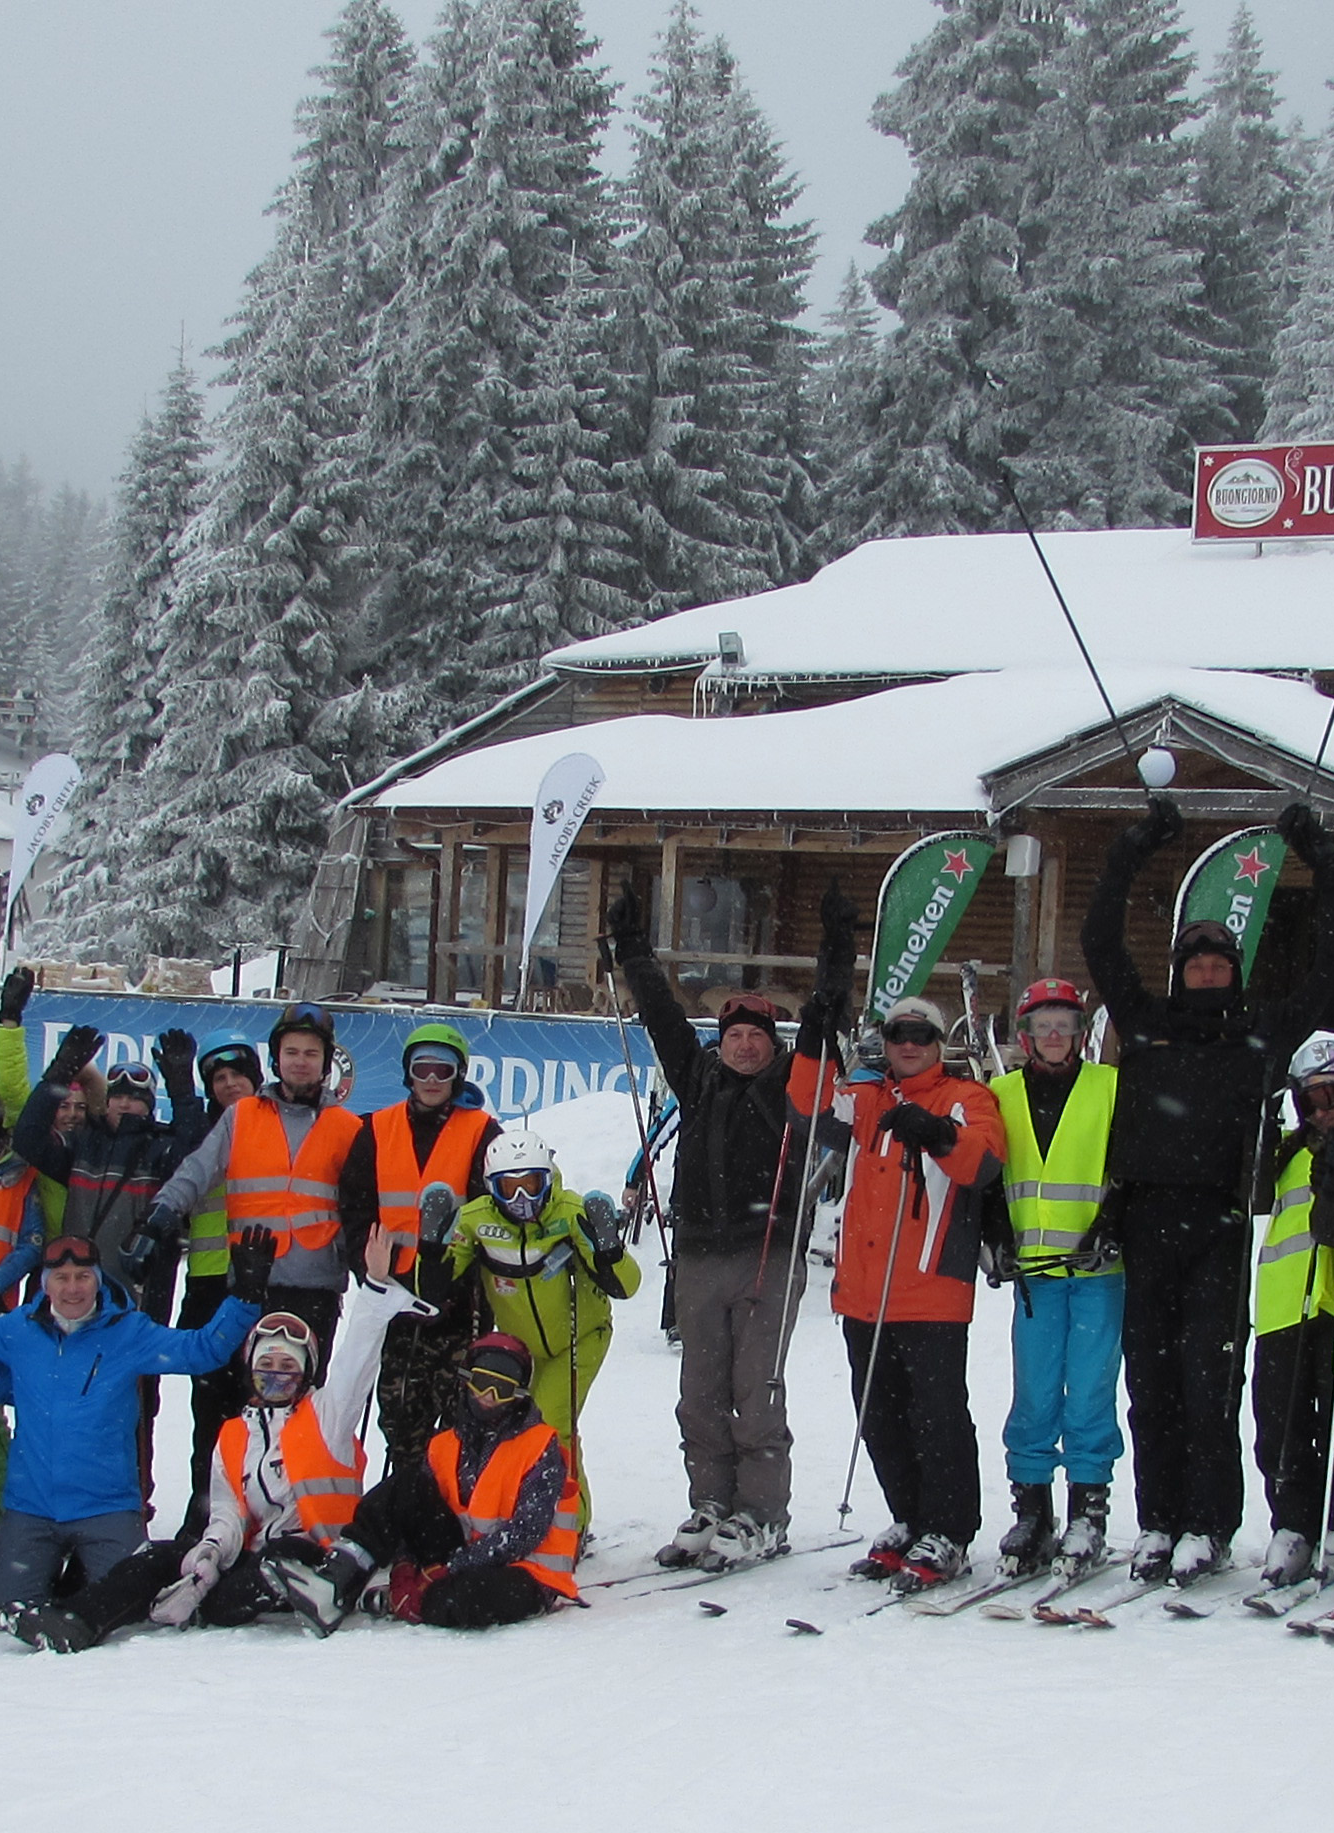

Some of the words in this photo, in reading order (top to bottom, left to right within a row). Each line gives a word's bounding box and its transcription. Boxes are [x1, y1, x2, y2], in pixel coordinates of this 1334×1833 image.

[1215, 487, 1278, 506] BUONGIORNO
[572, 774, 602, 818] CREEK
[1225, 894, 1254, 946] en
[872, 883, 956, 1019] Heineken
